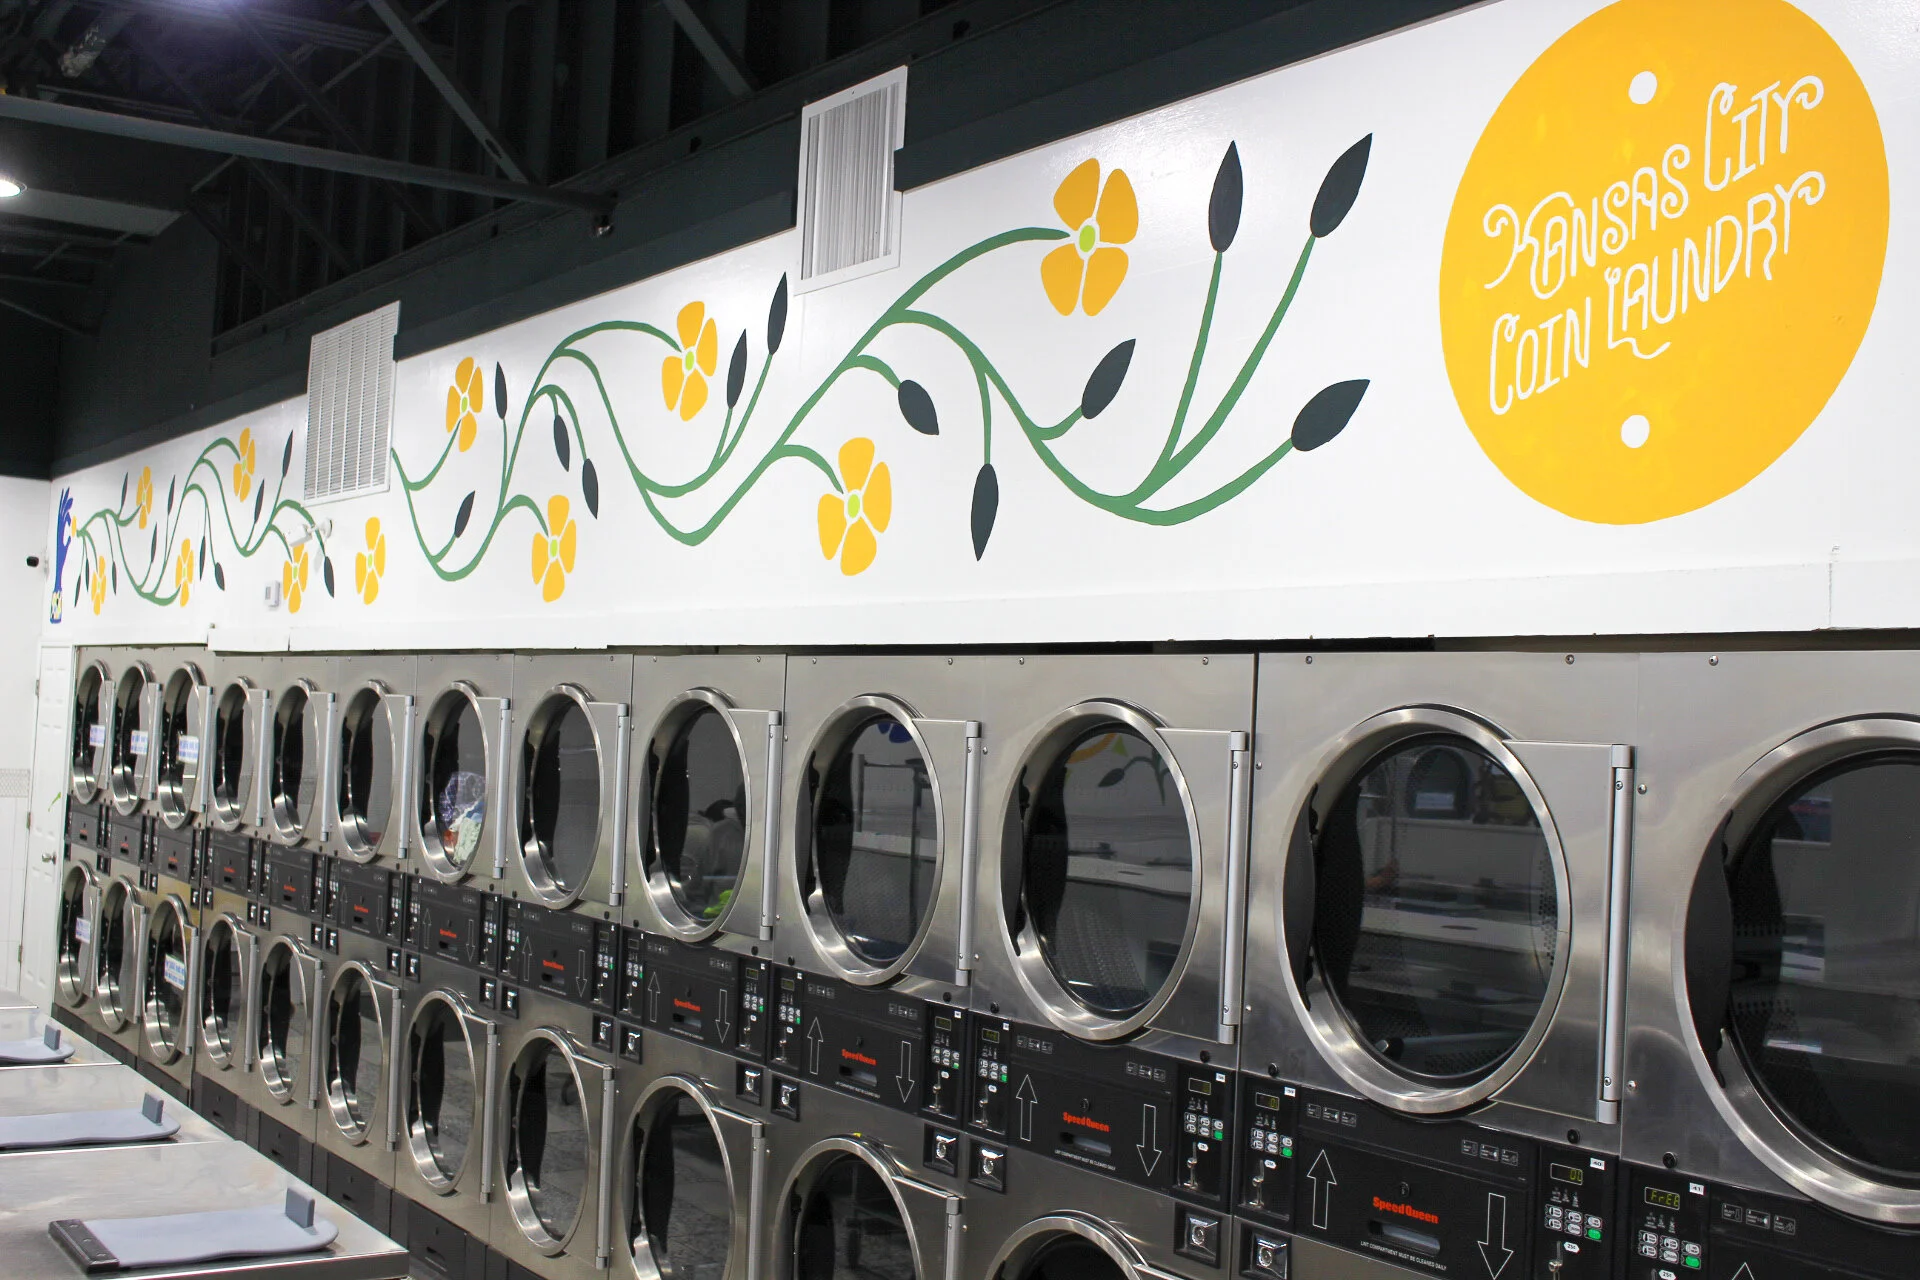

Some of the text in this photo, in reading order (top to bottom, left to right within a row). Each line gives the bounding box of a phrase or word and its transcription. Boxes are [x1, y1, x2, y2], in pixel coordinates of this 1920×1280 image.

[1483, 75, 1825, 300] KANSAS CITY
[1489, 170, 1826, 416] COIN LAUNDRY
[1373, 1196, 1440, 1225] Speed Queen
